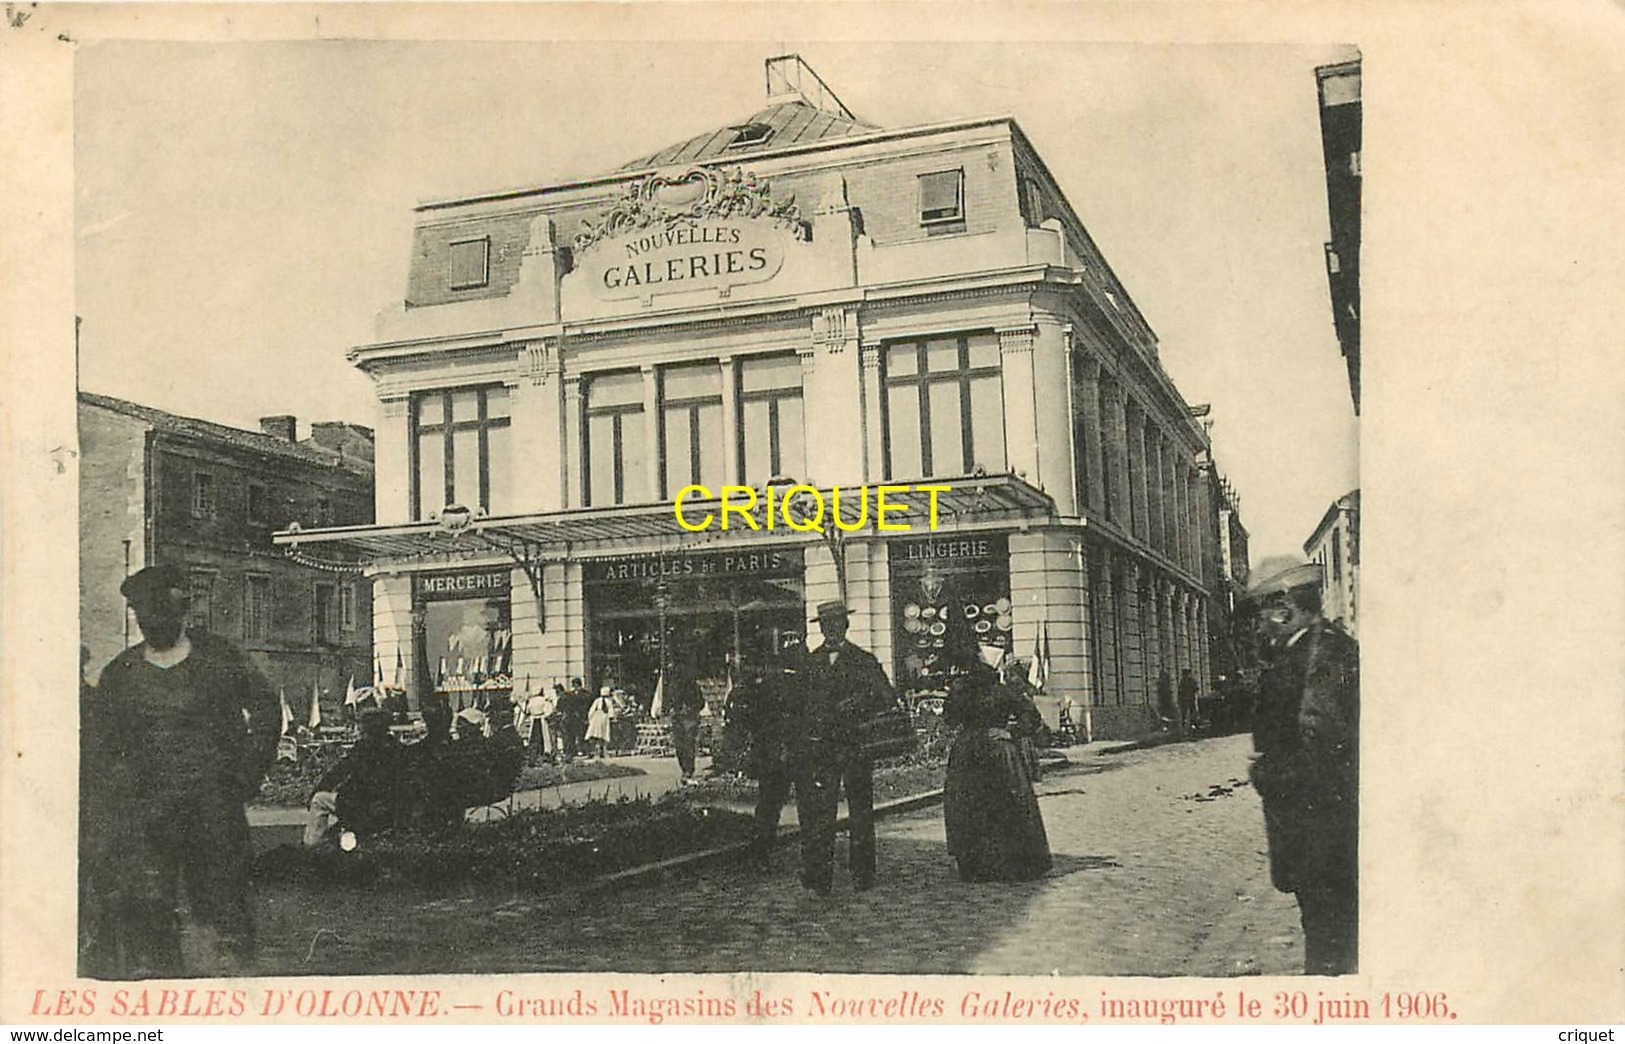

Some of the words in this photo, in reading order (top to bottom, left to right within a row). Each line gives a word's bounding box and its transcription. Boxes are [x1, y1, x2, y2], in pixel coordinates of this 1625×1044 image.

[625, 227, 741, 259] NOUVELLES
[603, 248, 767, 289] GALERIES
[908, 540, 989, 559] LINGERIE
[606, 559, 694, 580] ARTICLES
[725, 552, 781, 572] PARIS
[424, 573, 502, 593] MERCERIE
